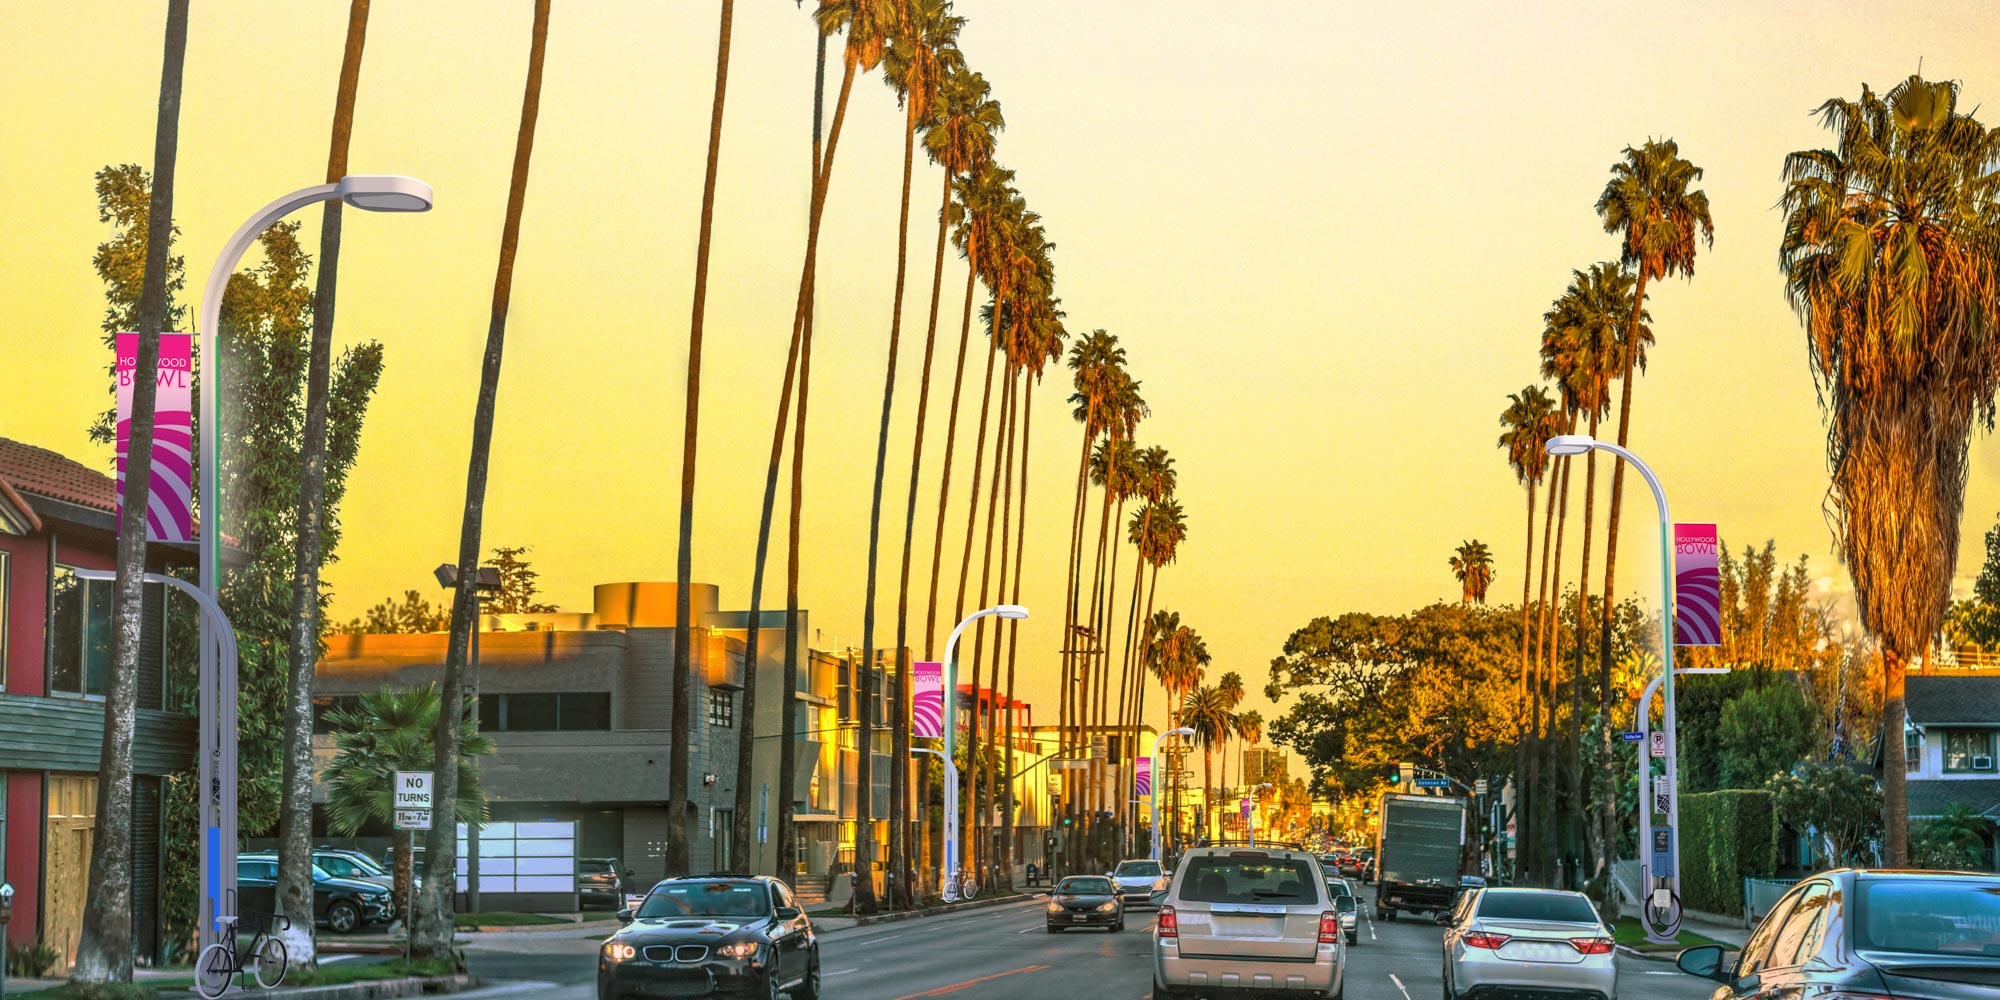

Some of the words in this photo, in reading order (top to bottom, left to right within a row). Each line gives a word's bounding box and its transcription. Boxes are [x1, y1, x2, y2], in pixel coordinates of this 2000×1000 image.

[120, 356, 186, 368] HOOOD
[120, 369, 186, 388] BWL
[1676, 543, 1715, 555] BOWL
[406, 778, 423, 788] NO
[398, 793, 430, 802] TURNS
